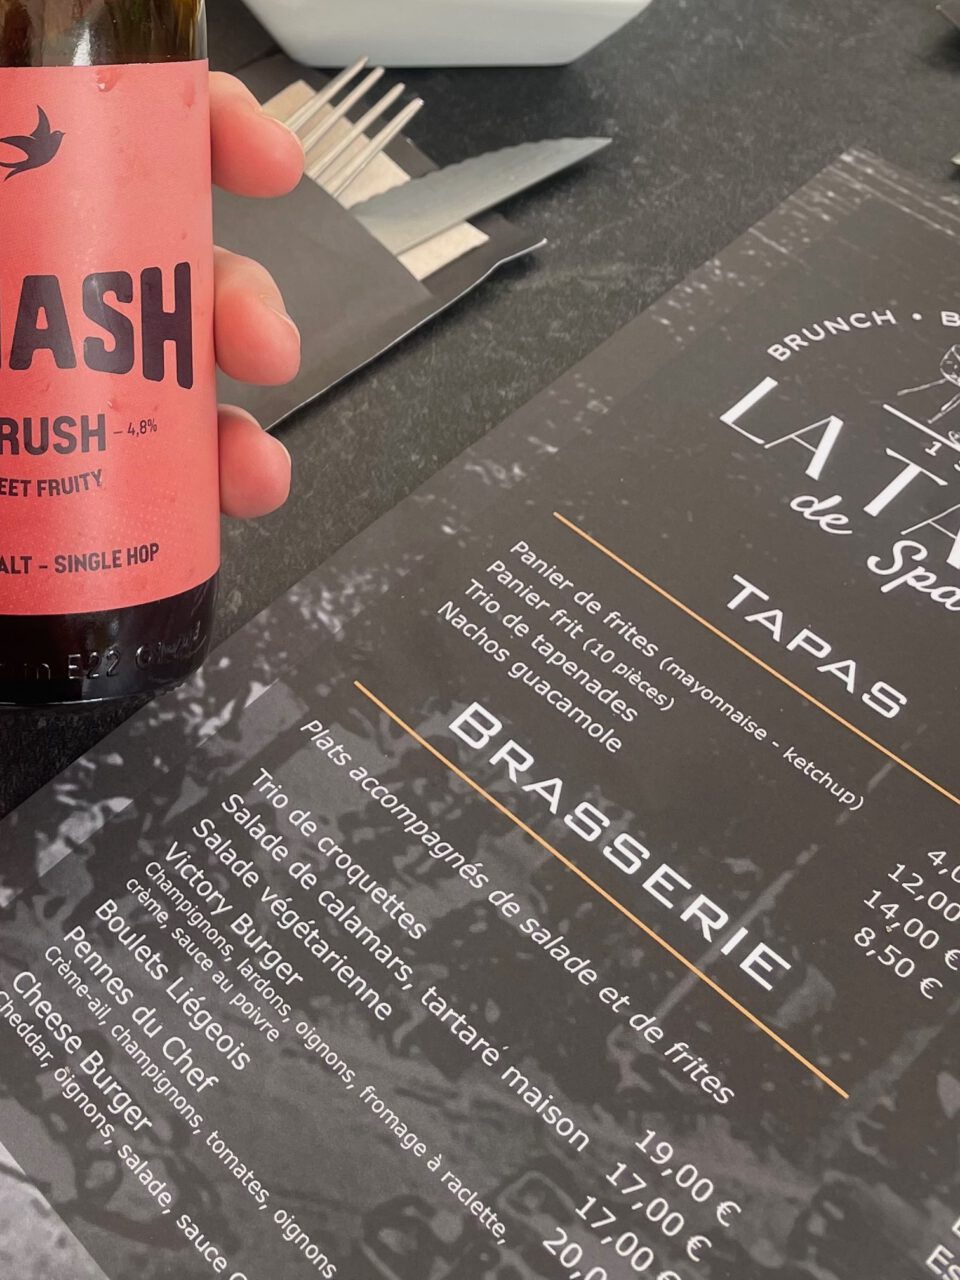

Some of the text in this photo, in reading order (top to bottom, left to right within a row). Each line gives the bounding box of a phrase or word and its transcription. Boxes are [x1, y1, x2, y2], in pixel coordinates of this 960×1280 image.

[127, 418, 158, 437] 4,8%
[719, 376, 844, 481] LA
[767, 309, 897, 362] BRUNCH
[37, 469, 103, 497] FRUITY
[54, 549, 122, 574] SINGLE
[127, 542, 160, 566] HOP
[790, 495, 852, 534] de
[486, 560, 960, 922] Panier frit (10 pièces) 12,00
[510, 540, 574, 590] Panier
[573, 590, 602, 615] de
[603, 611, 659, 658] frites
[659, 656, 768, 741] (mayonnaise
[782, 746, 865, 811] ketchup)
[727, 574, 908, 719] TAPAS
[437, 601, 943, 1000] Nachos guacamole 8,50 €
[448, 701, 792, 991] BRASSERIE
[464, 578, 501, 615] Trio
[502, 612, 530, 638] de
[531, 634, 638, 723] tapenades
[864, 889, 940, 950] 14,00
[95, 898, 251, 1071] Boulets Liégeois
[126, 878, 280, 1042] crème, sauce au poivre
[165, 841, 233, 916] Victory
[230, 913, 304, 986] Burger
[252, 767, 742, 1227] Trio de croquettes 19,00 €
[299, 719, 736, 1104] Plats accompagnés de salade et de frites
[12, 971, 153, 1132] Cheese Burger
[63, 925, 220, 1093] Pennes du Chef
[145, 861, 506, 1246] Champignons, lardons, oignons, fromage à raclette,
[192, 818, 655, 1272] Salade végétarienne 17,00
[221, 793, 289, 862] Salade
[288, 861, 317, 890] de
[317, 890, 414, 991] calamars,
[501, 1066, 590, 1152] maison
[605, 1161, 685, 1236] 17,00
[686, 1235, 713, 1262] €
[44, 946, 337, 1279] Crème-ail, champignons, tomates, oignons
[54, 1067, 115, 1145] oignons,
[117, 1144, 172, 1216] salade,
[176, 1214, 228, 1273] sauce
